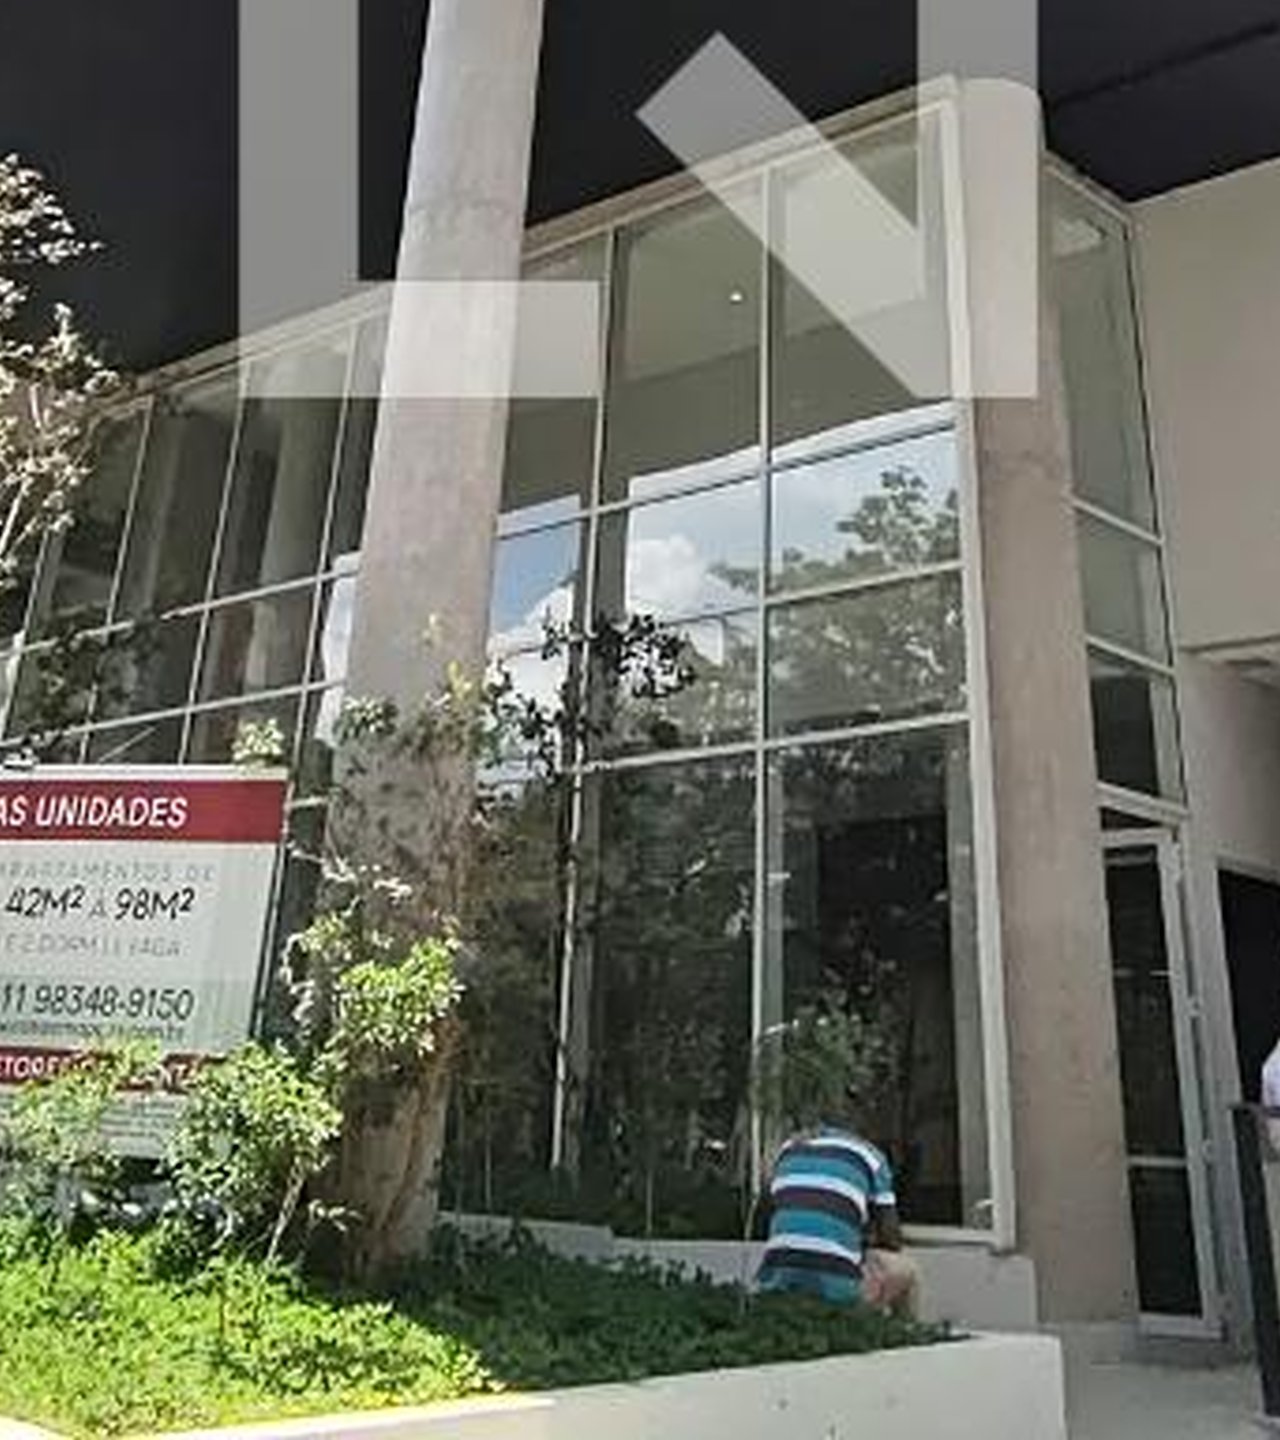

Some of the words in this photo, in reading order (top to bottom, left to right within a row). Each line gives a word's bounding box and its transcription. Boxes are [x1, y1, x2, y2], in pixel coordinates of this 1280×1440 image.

[34, 794, 189, 830] UNIDADES
[114, 887, 196, 921] 98M²
[2, 982, 27, 1013] 11
[33, 984, 196, 1021] 98348-9150
